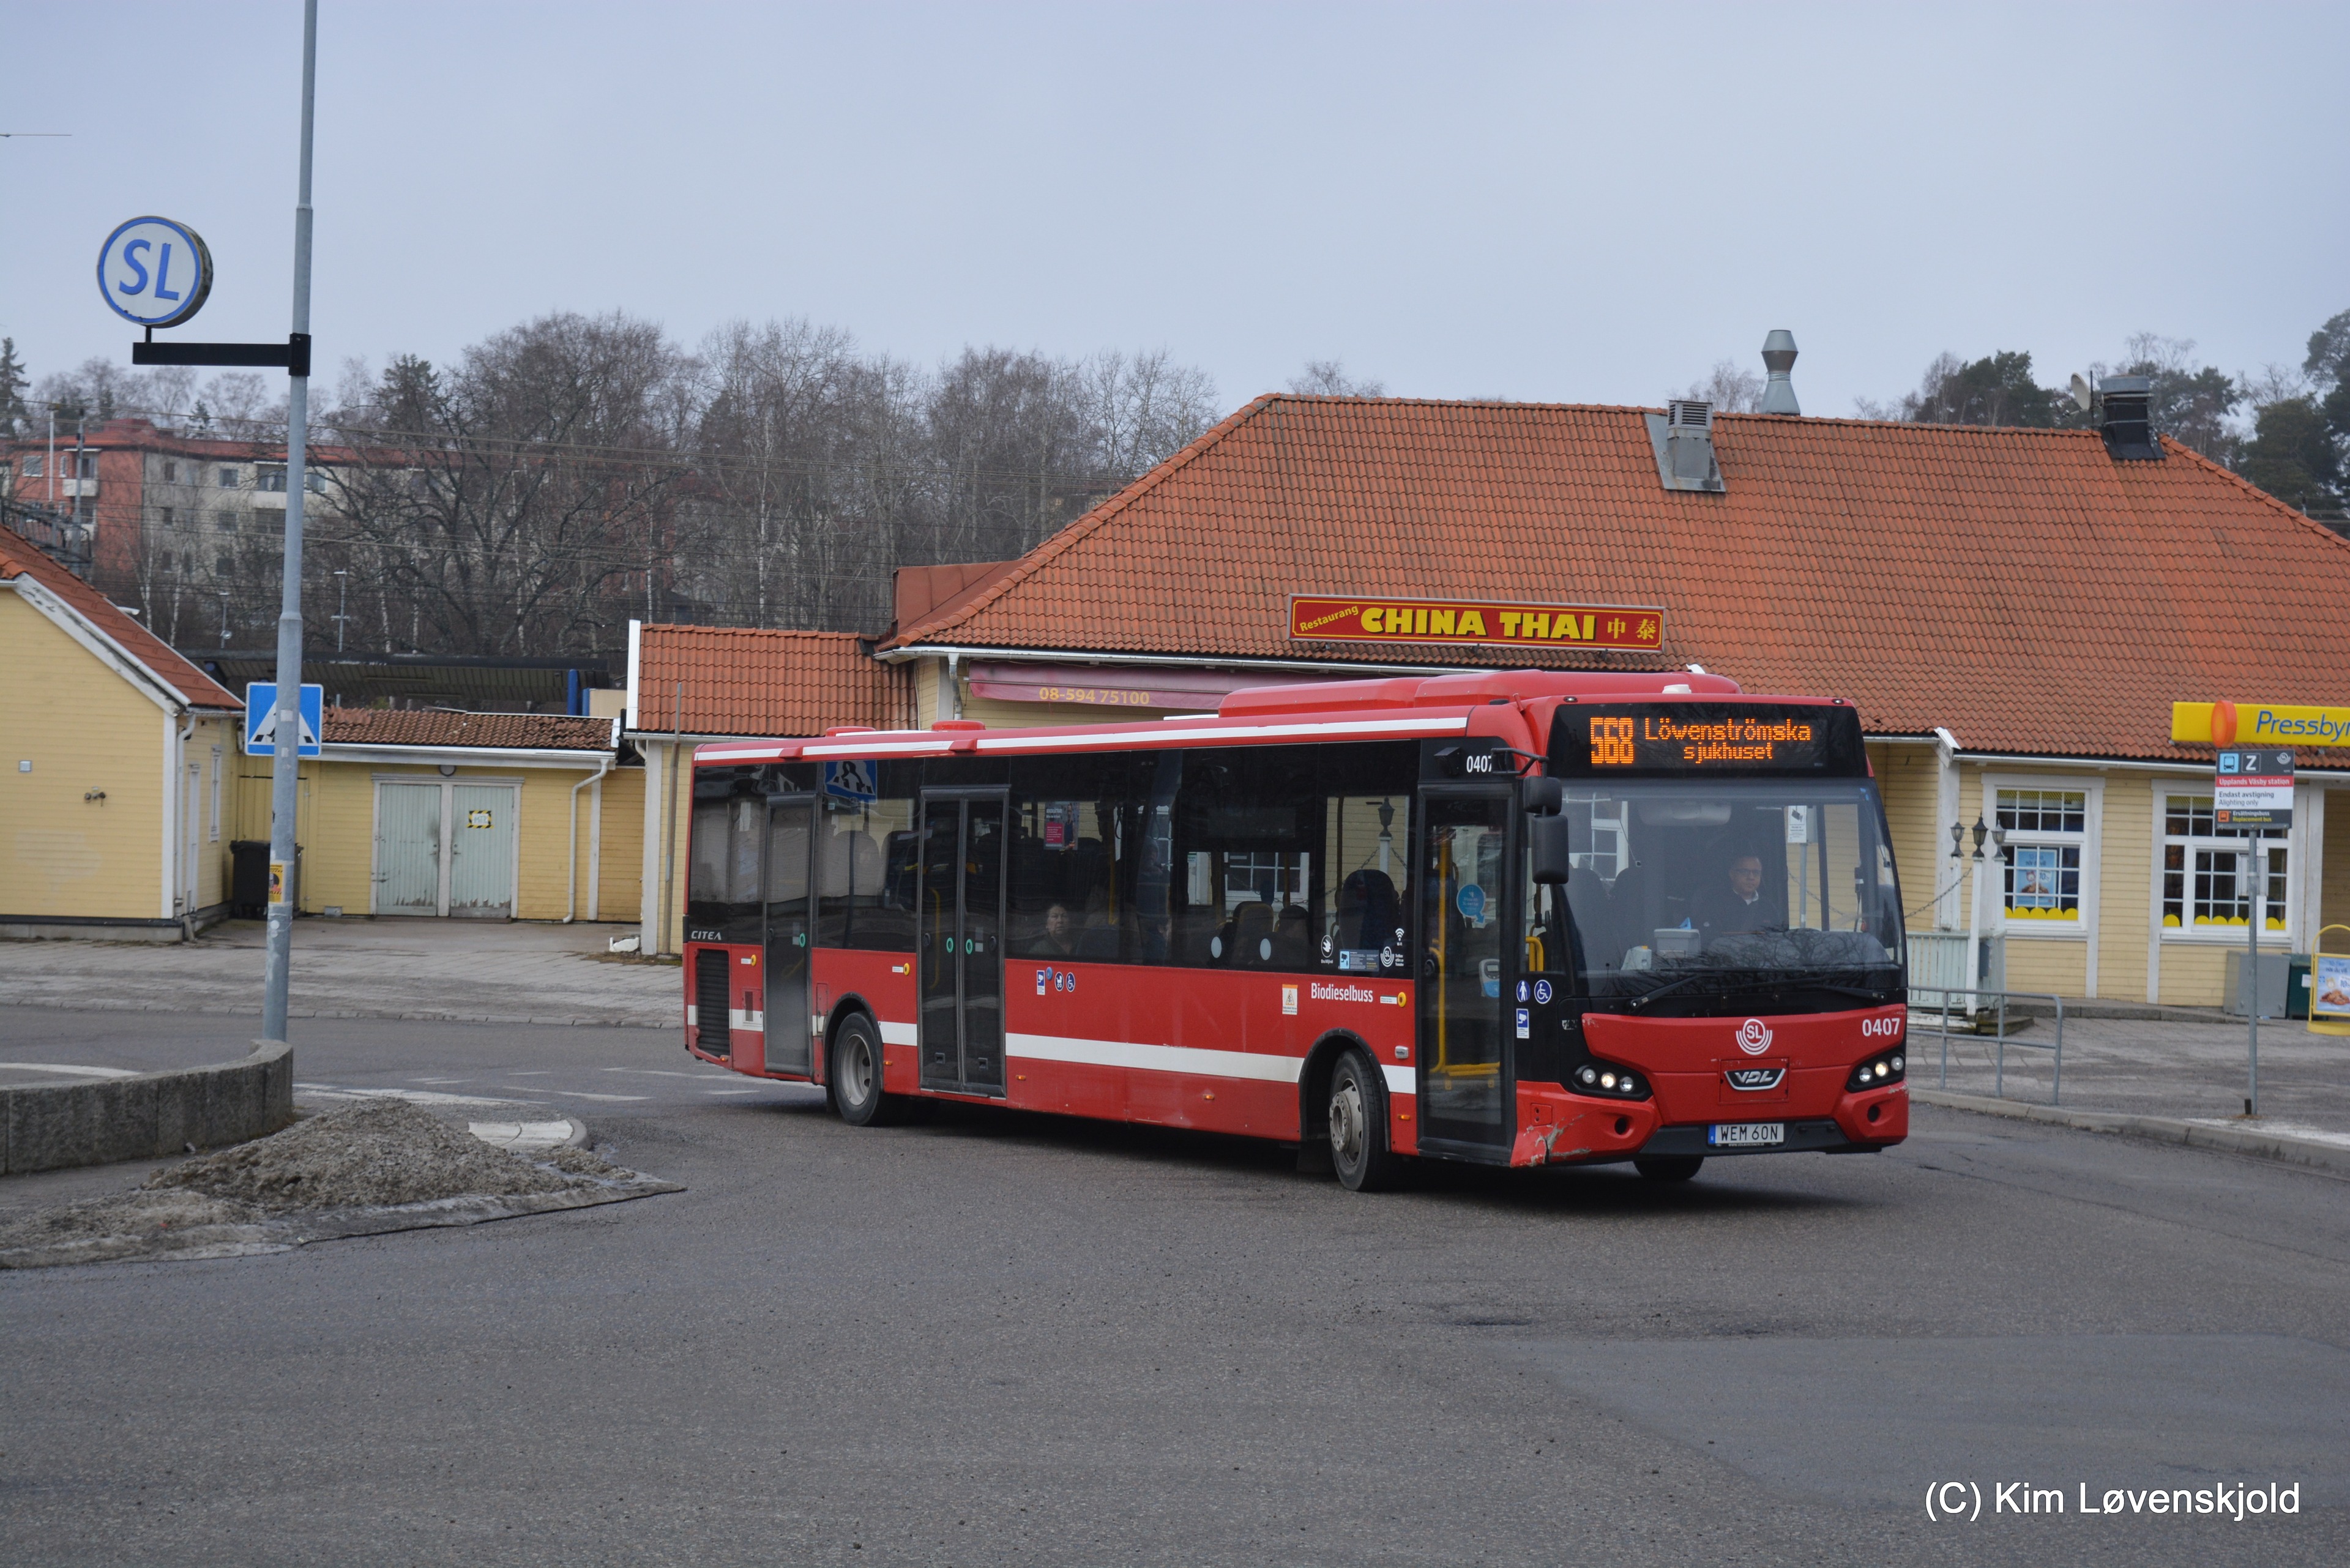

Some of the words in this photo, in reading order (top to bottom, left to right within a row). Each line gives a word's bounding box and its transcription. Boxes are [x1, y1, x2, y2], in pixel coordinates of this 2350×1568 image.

[119, 239, 179, 301] SL
[1299, 605, 1359, 632] Restaurang
[1360, 607, 1486, 636] CHINA
[1499, 611, 1596, 640] THAI
[1039, 687, 1095, 703] 08-594
[1100, 690, 1150, 705] 75100
[1645, 717, 1811, 741] Löwenströmska
[1590, 717, 1634, 764] 568
[1684, 742, 1773, 764] sjukhuset
[2245, 755, 2257, 771] Z
[2219, 778, 2248, 787] Upplands
[2248, 778, 2267, 786] Väsby
[691, 930, 722, 941] CITEA
[1311, 982, 1373, 1002] Biodieselbuss
[1747, 1025, 1762, 1039] SL
[1862, 1018, 1900, 1037] 0407
[1734, 1070, 1774, 1084] VDL
[1720, 1126, 1747, 1141] WEM
[1751, 1126, 1778, 1140] 60N
